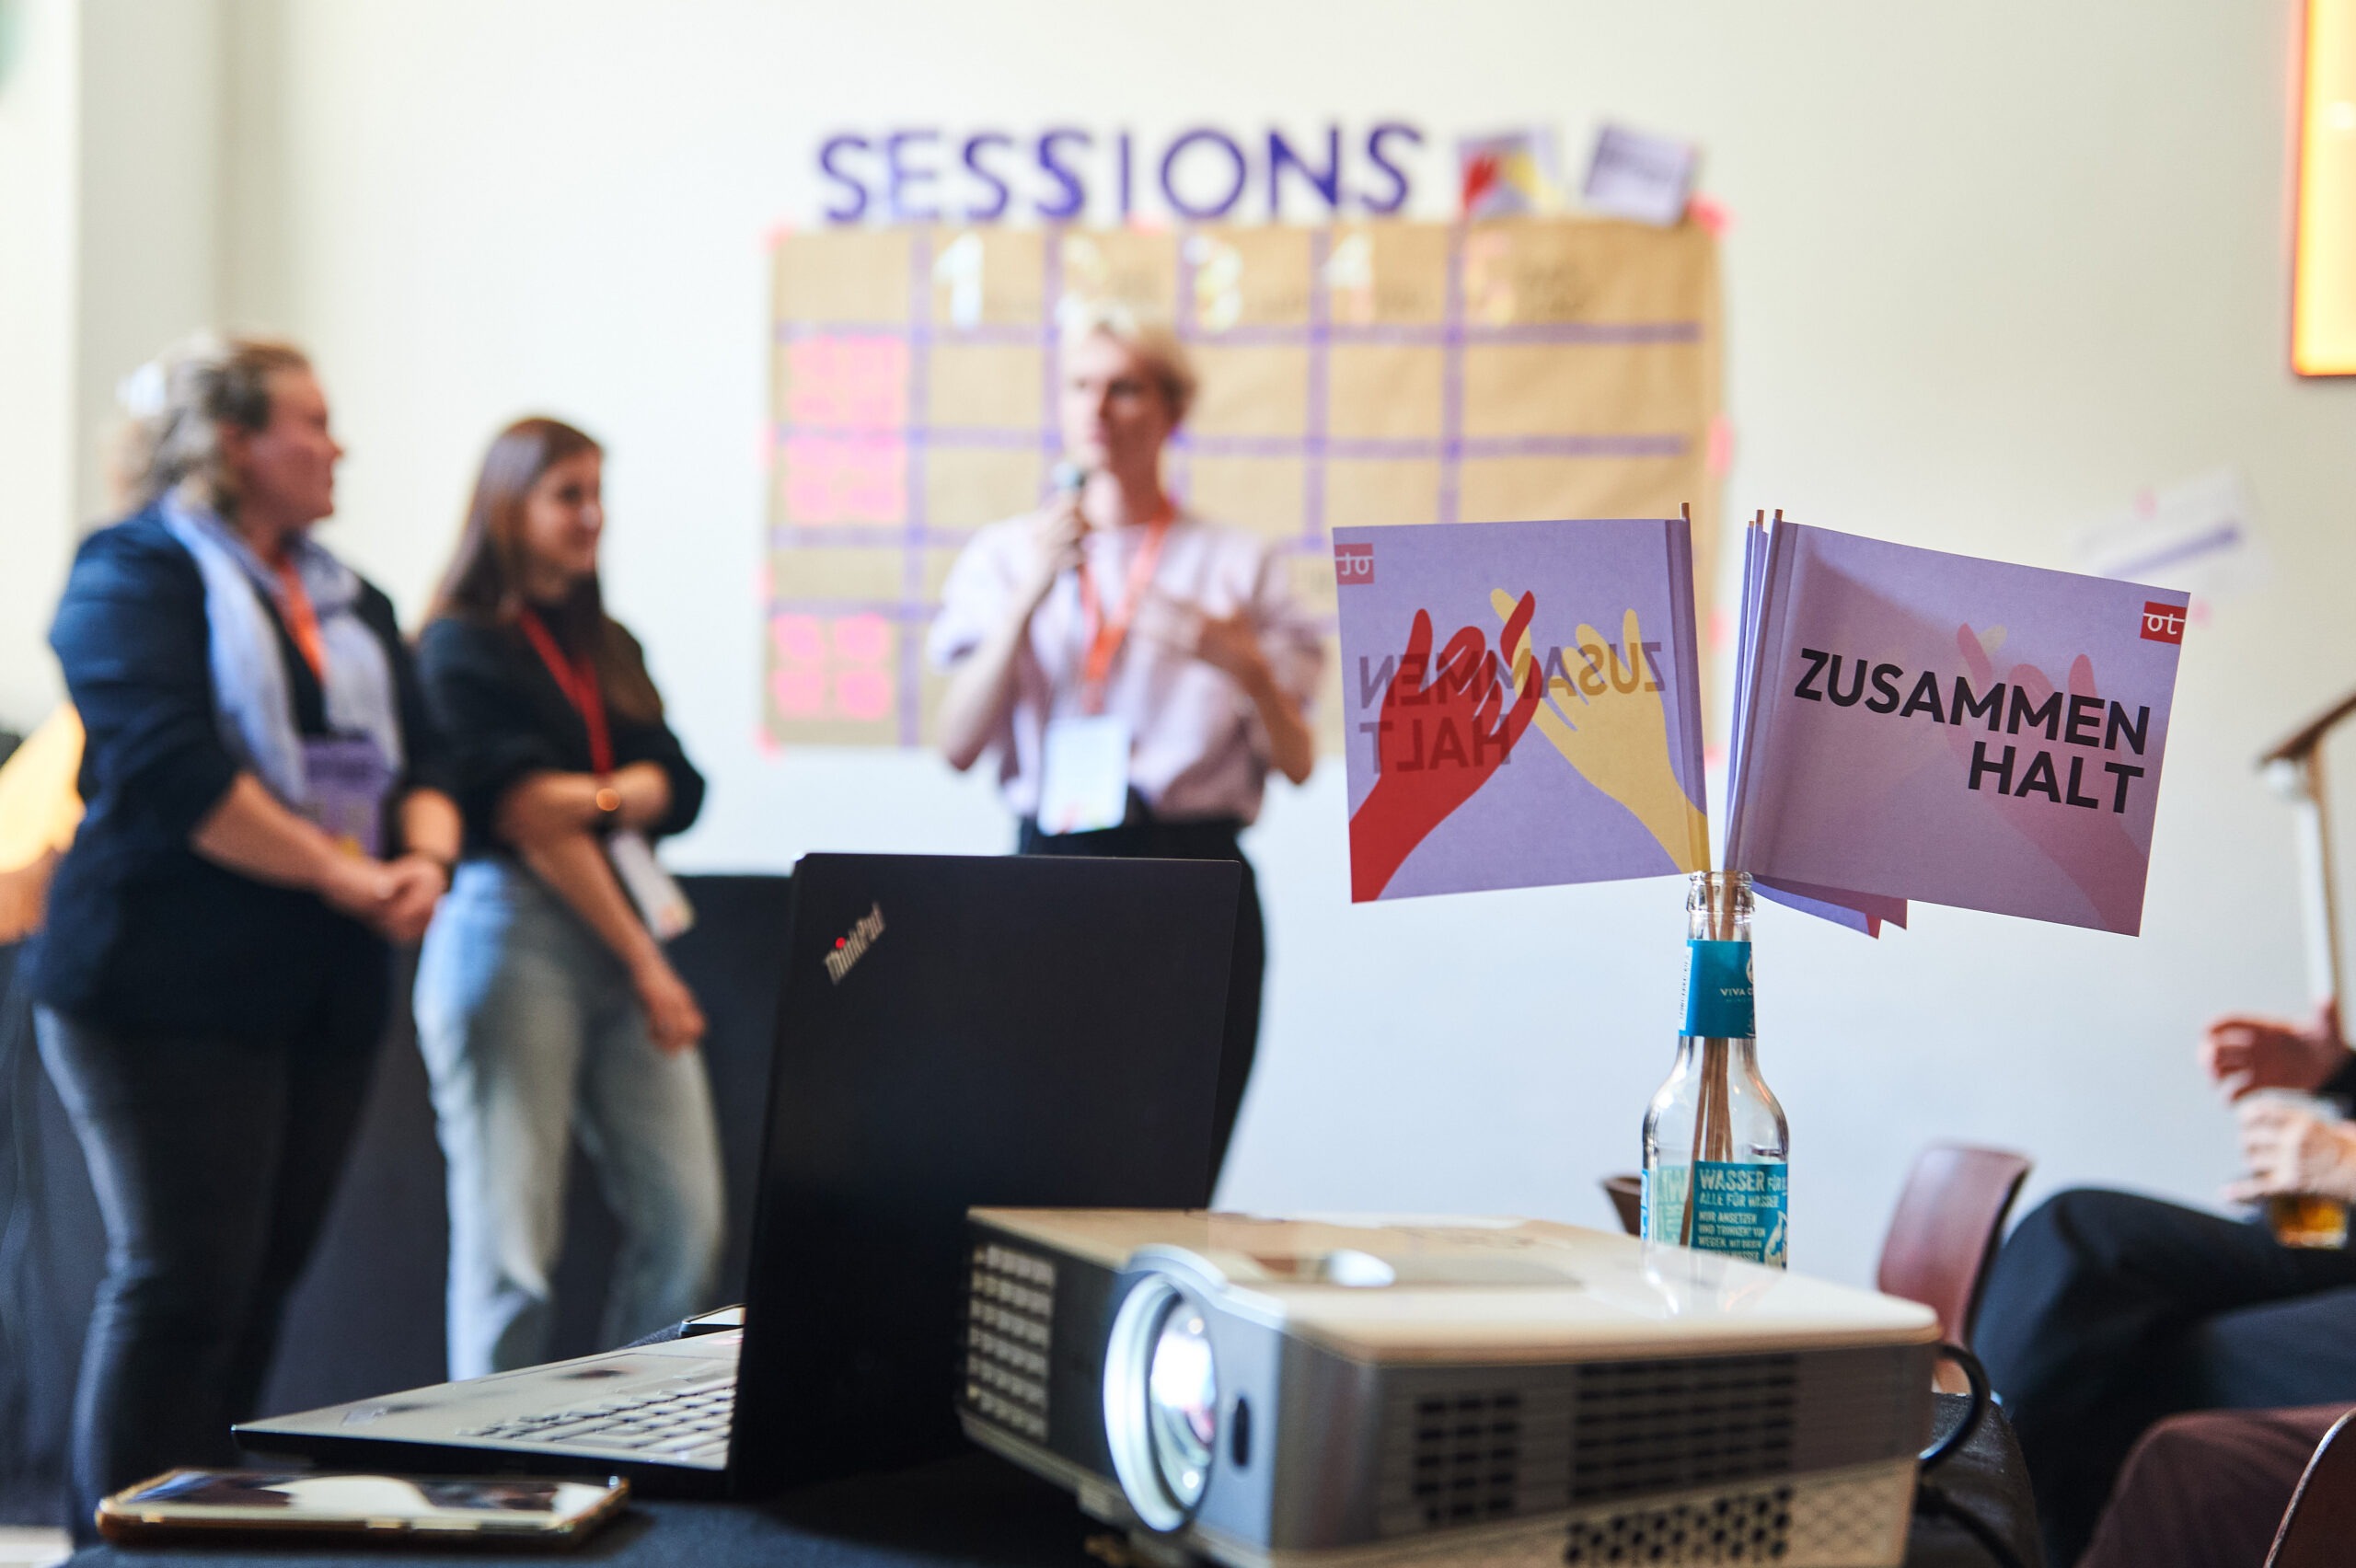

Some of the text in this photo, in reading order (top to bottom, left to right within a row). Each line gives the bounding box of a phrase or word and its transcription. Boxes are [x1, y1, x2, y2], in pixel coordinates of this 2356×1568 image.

[820, 125, 1423, 222] SESSIONS
[933, 234, 982, 326] 1
[1795, 648, 2150, 755] ZUSAMMEN
[1968, 740, 2144, 813] HALT
[824, 902, 886, 985] ThinkPad
[1720, 988, 1746, 997] VIVA
[1699, 1169, 1765, 1192] WASSER
[1699, 1211, 1716, 1223] NUR
[1700, 1193, 1724, 1205] ALLE
[1726, 1192, 1746, 1207] FÜR
